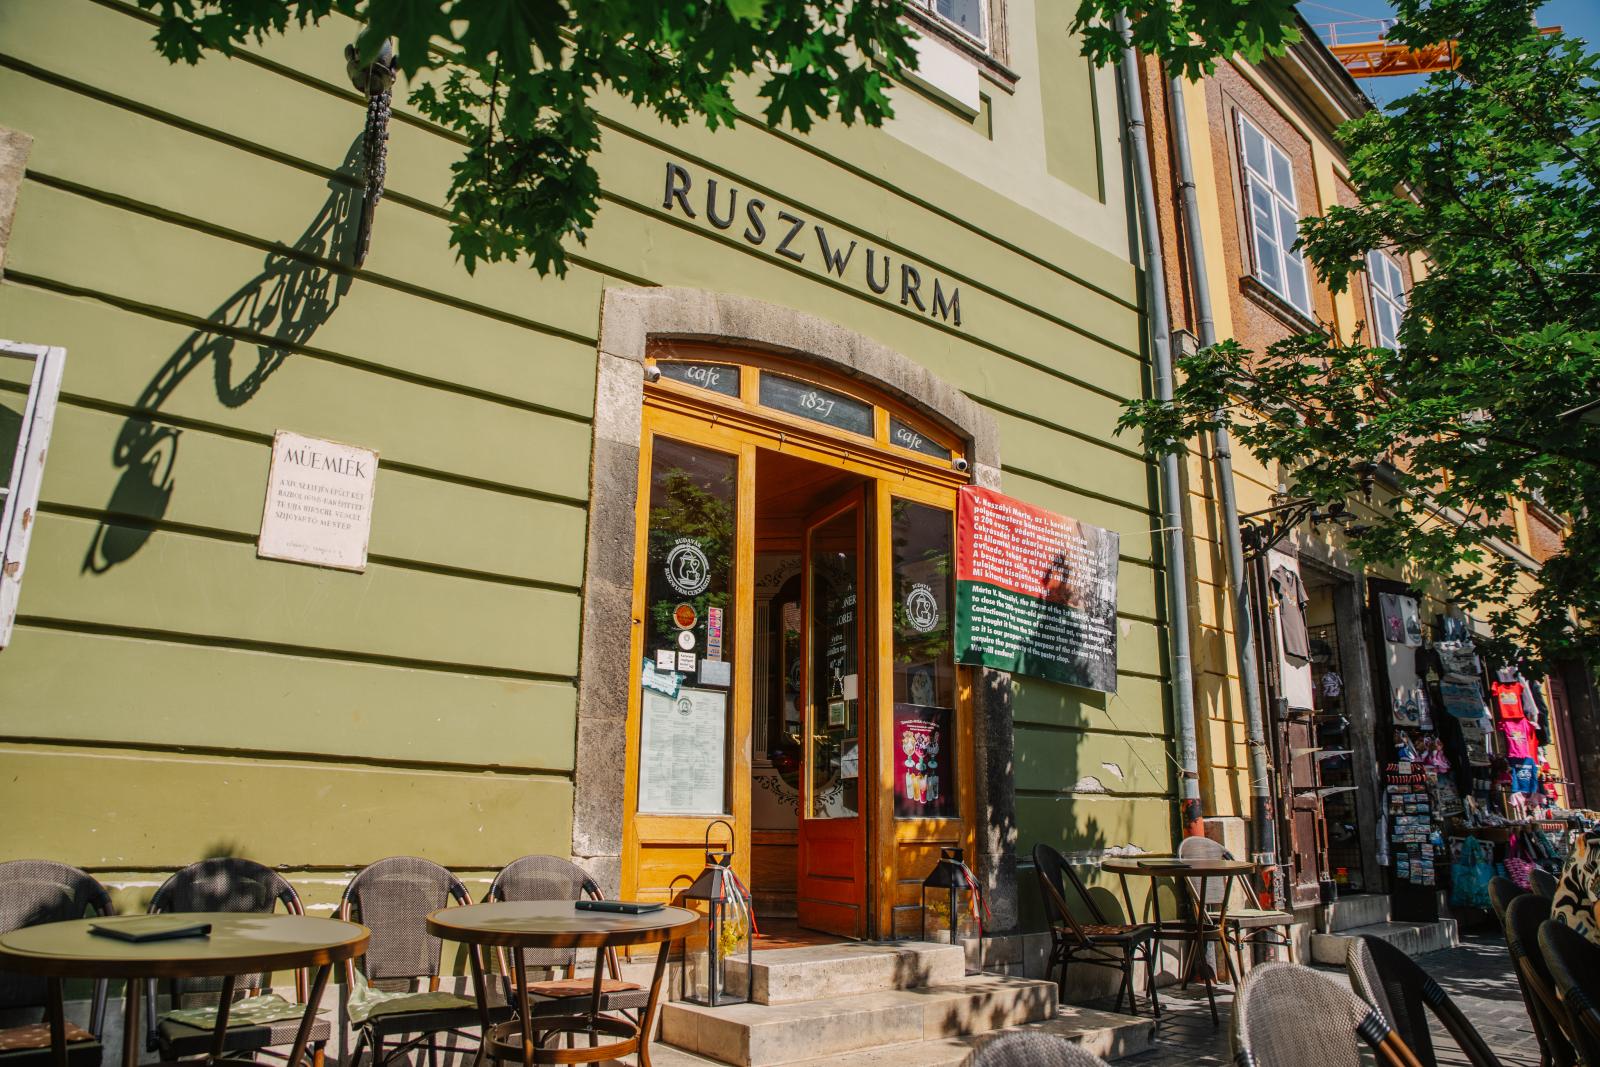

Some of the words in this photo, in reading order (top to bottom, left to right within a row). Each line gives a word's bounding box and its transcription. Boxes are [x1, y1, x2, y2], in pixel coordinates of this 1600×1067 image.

[663, 161, 962, 327] RUSZWURM
[799, 391, 834, 417] 1827
[981, 515, 992, 525] 200
[1014, 528, 1034, 538] védett
[972, 549, 978, 558] A
[972, 567, 982, 576] Mi
[972, 584, 991, 596] Márta
[1019, 597, 1028, 606] the
[980, 596, 995, 605] close
